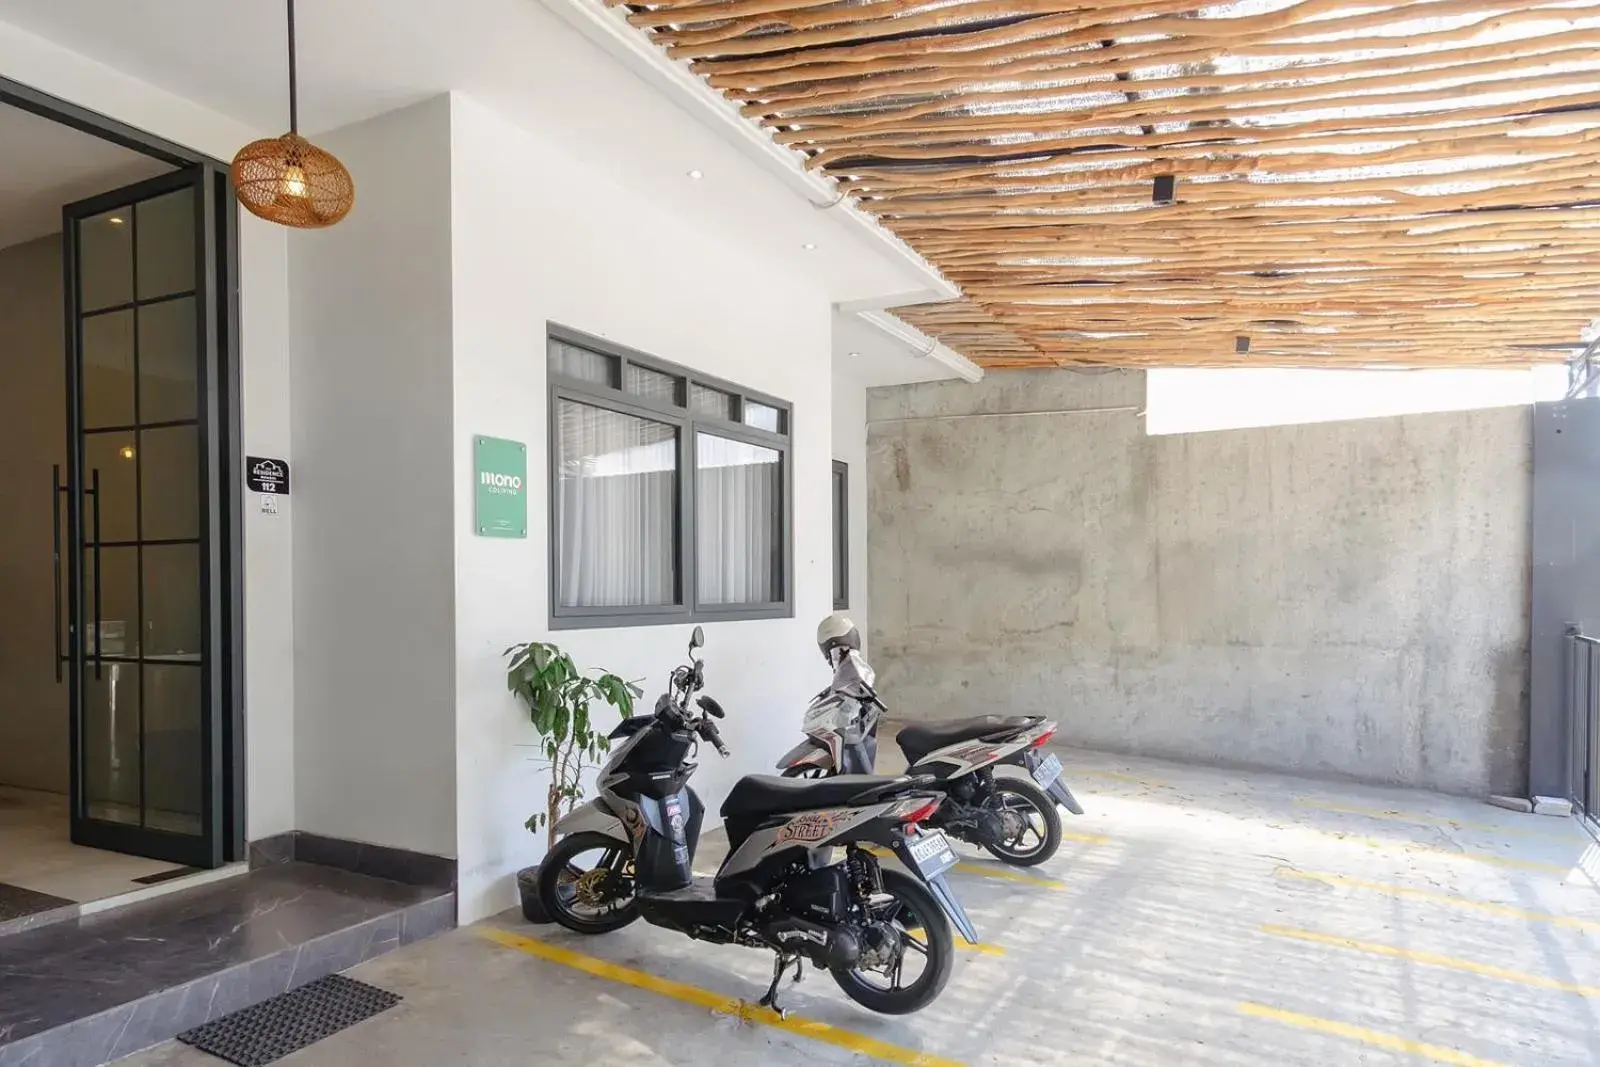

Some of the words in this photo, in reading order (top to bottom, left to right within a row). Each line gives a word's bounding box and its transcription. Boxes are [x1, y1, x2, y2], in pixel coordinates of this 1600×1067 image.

[253, 467, 283, 477] RESIDENCE
[481, 471, 521, 489] mono
[262, 482, 276, 492] 112
[488, 487, 517, 496] COLIVING
[784, 822, 828, 838] STREET
